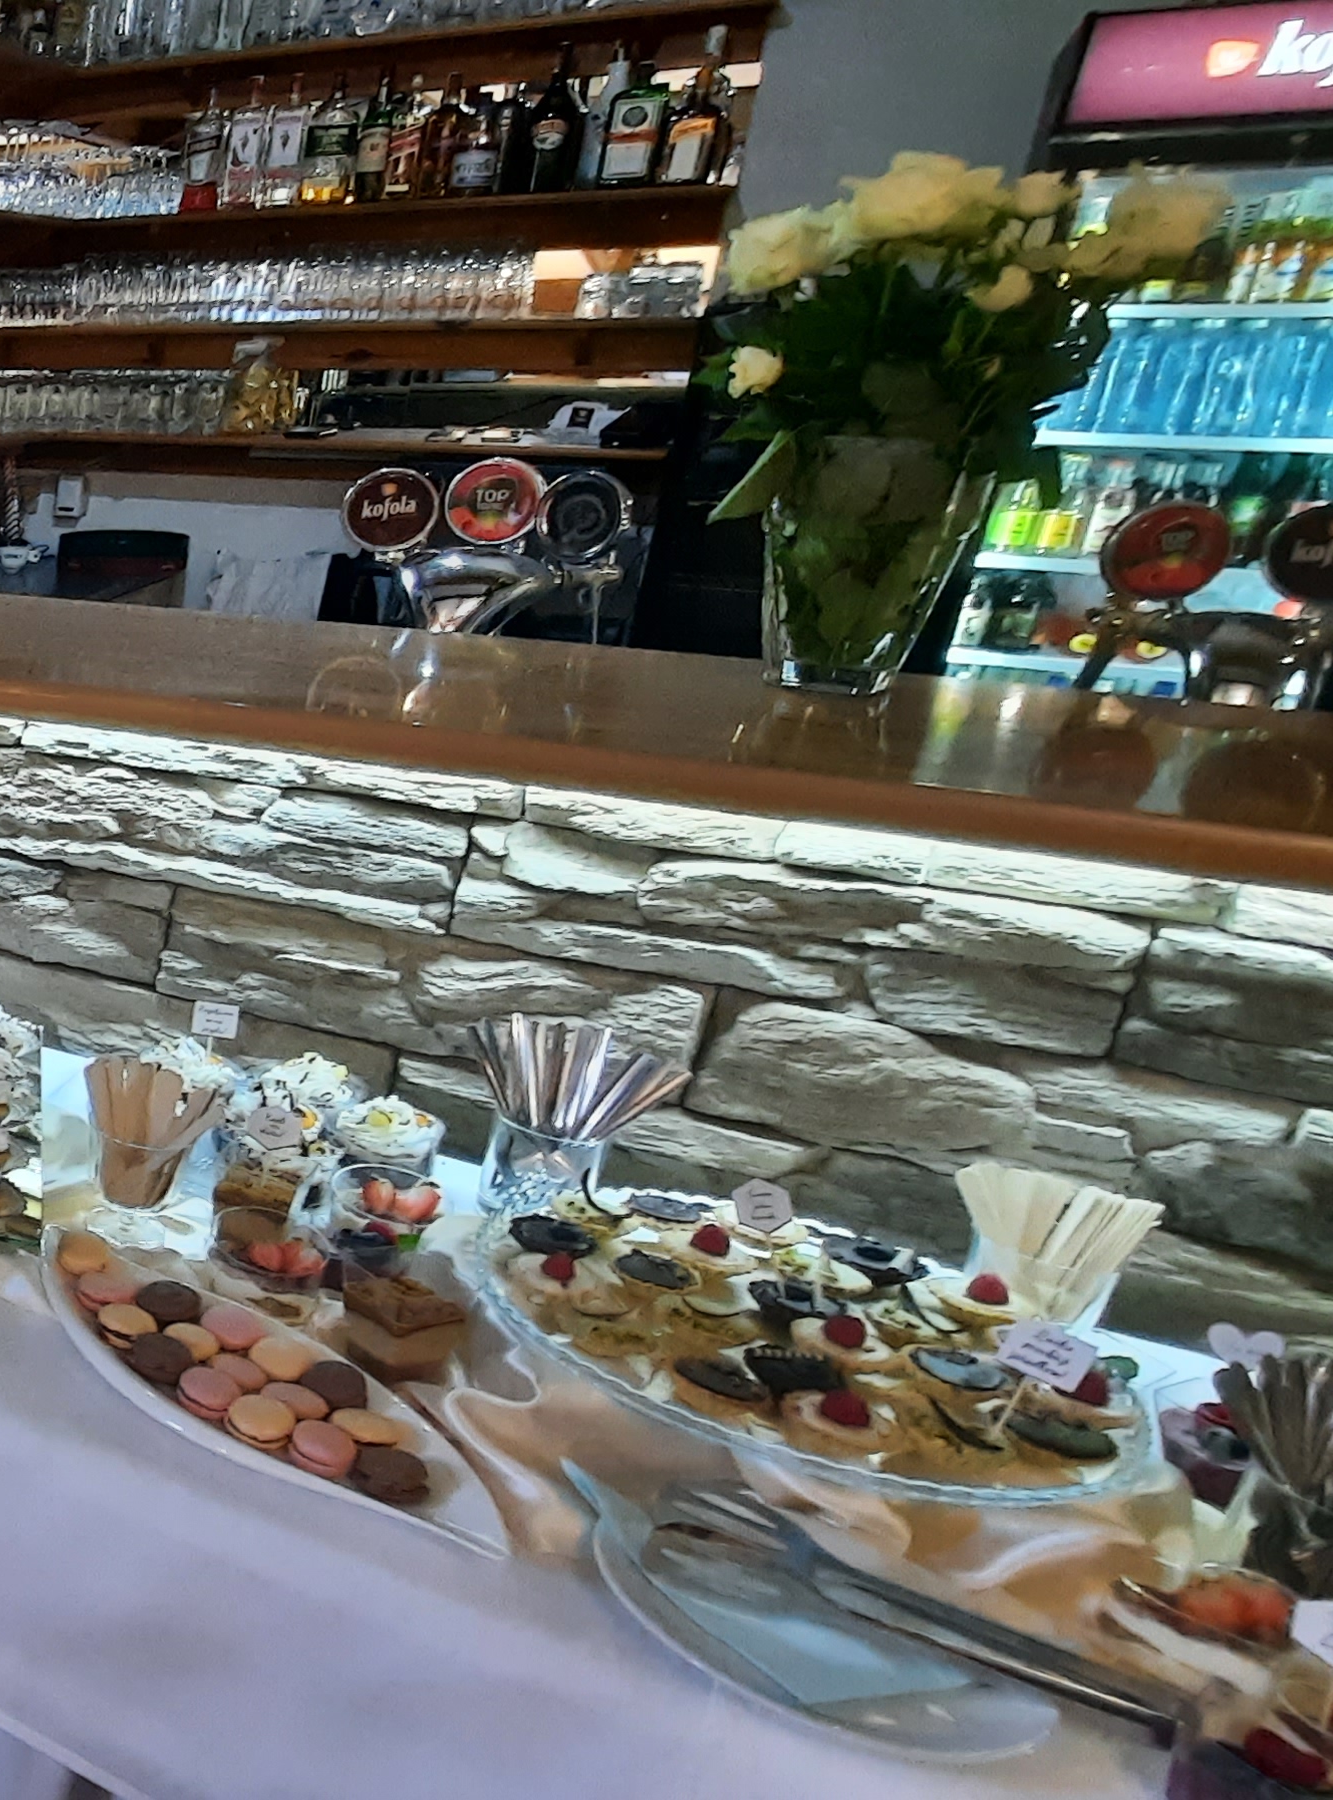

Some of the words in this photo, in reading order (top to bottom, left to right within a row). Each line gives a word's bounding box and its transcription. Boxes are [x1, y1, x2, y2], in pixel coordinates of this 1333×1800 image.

[1255, 17, 1333, 88] ko
[361, 494, 417, 522] kofola
[475, 488, 511, 502] TOP
